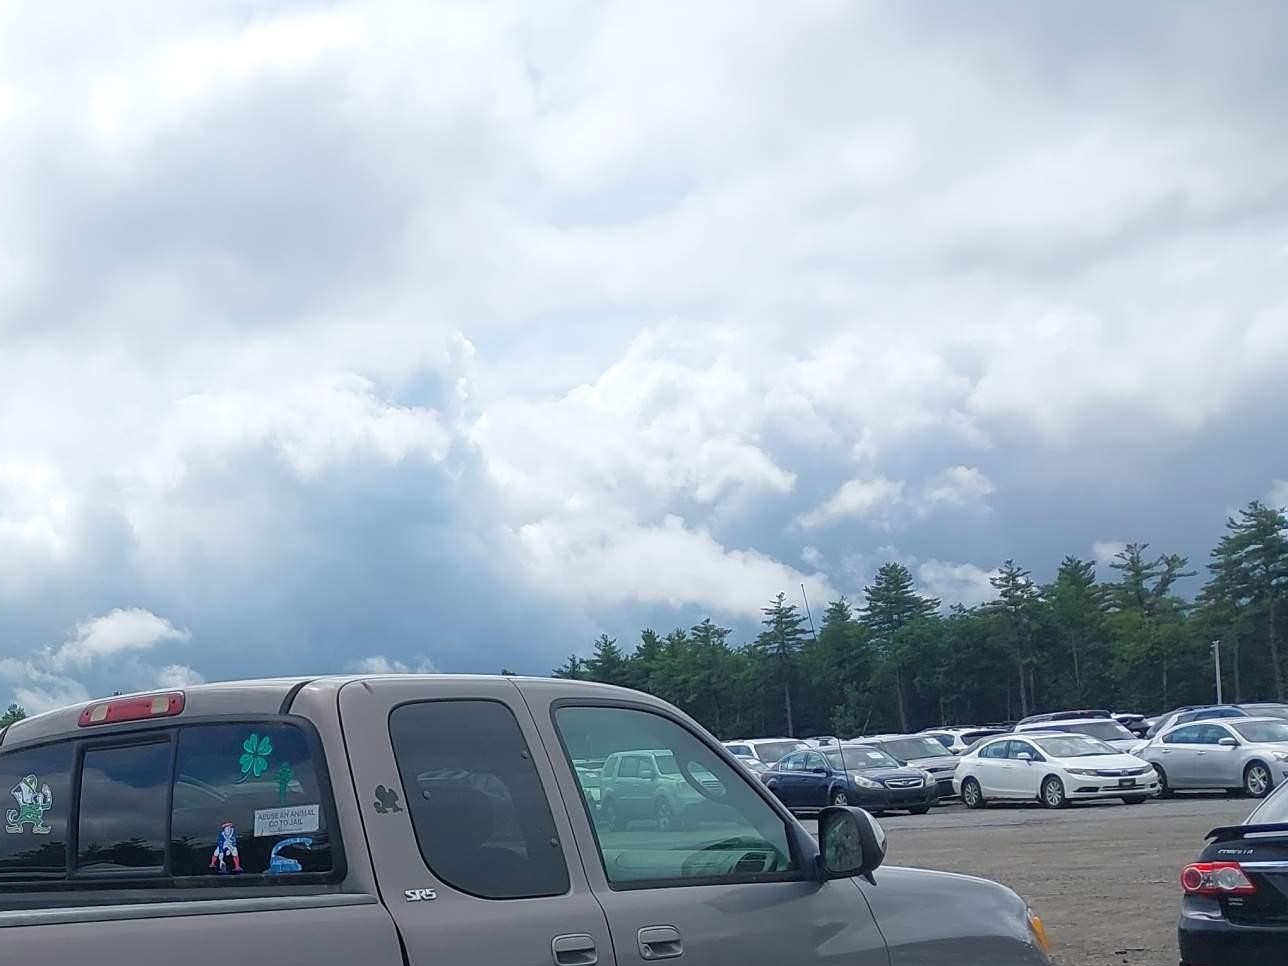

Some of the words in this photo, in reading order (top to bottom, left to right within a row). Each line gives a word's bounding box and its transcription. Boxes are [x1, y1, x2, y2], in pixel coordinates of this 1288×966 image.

[258, 813, 278, 821] ABUSE
[280, 812, 289, 820] AN
[290, 809, 315, 818] ANIMAL
[280, 819, 289, 827] TO
[289, 818, 303, 826] JAIL
[404, 888, 437, 902] SR5
